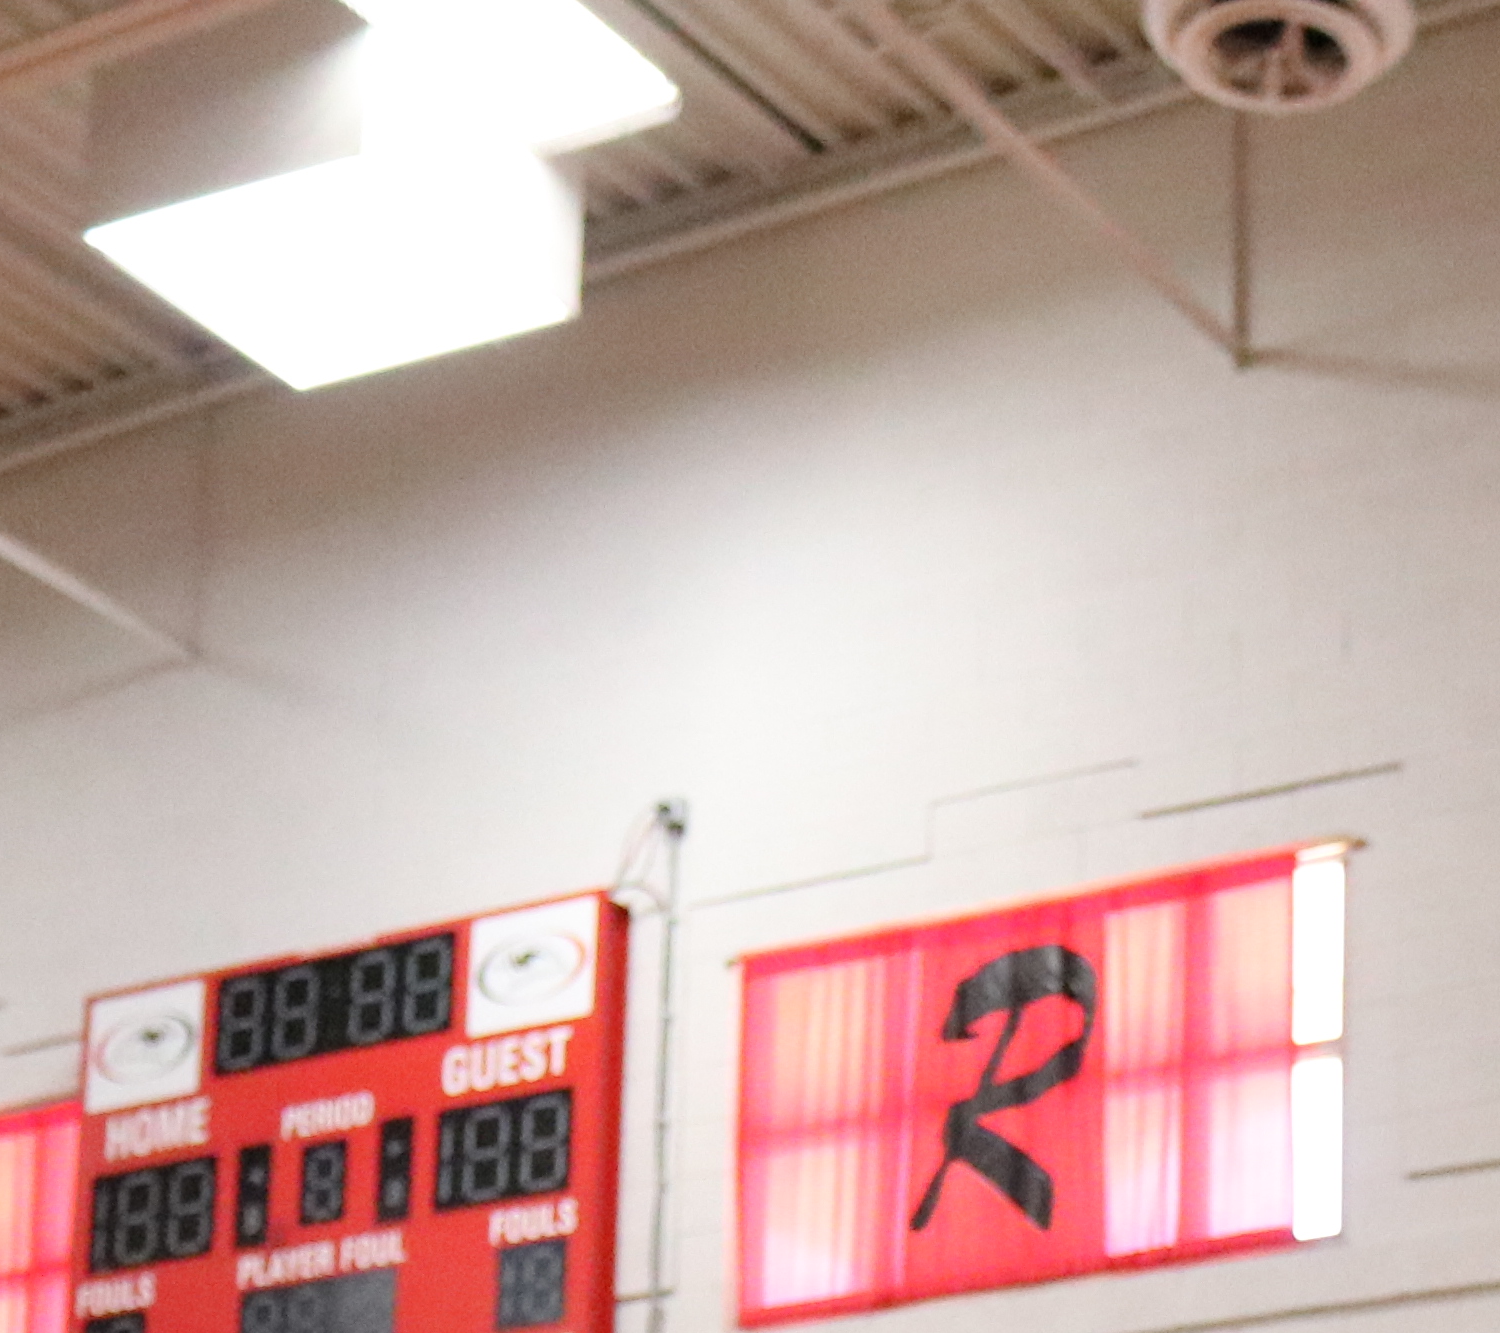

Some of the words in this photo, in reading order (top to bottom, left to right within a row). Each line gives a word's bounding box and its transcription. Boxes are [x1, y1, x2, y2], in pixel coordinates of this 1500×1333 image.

[441, 1027, 574, 1097] GUEST
[103, 1097, 211, 1161] HOME
[280, 1091, 375, 1140] PERIOD
[488, 1199, 578, 1247] FOULS
[236, 1242, 335, 1291] PLAYER
[340, 1231, 406, 1273] FOUL
[75, 1272, 157, 1318] FOULS
